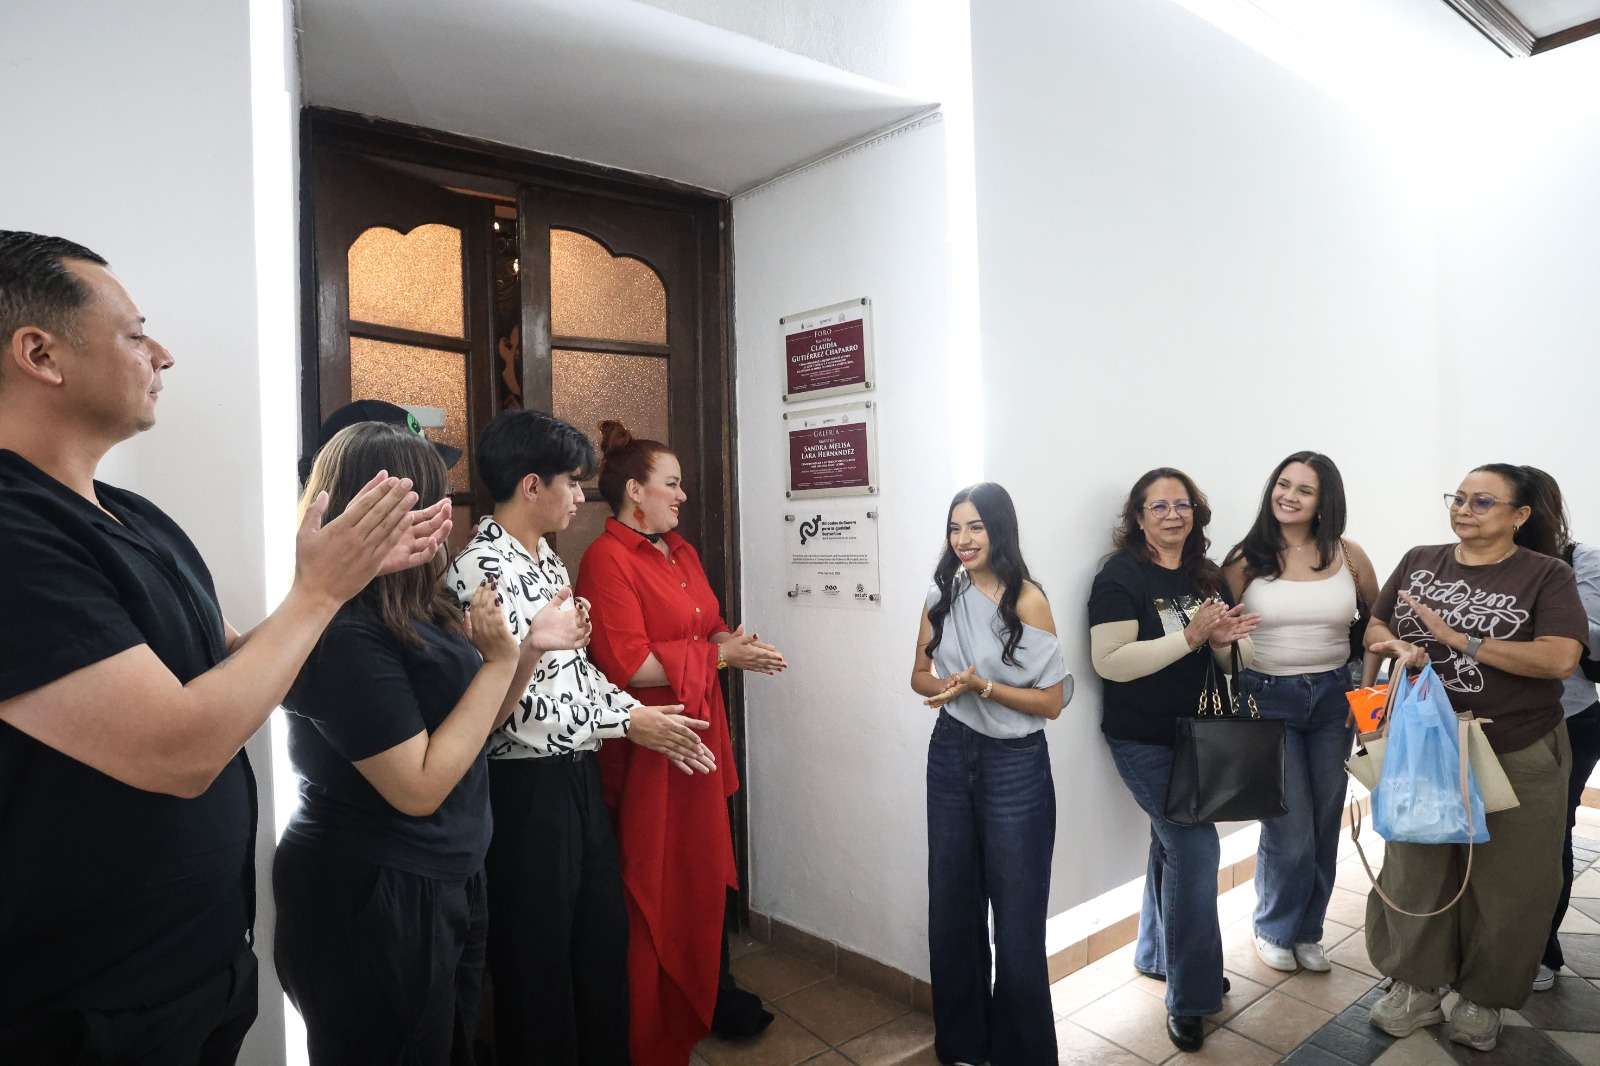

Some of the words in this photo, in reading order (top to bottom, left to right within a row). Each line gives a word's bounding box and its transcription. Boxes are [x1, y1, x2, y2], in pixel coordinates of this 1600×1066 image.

[814, 328, 832, 338] FORO
[810, 341, 837, 352] CLAUDIA
[825, 344, 859, 356] CHAPARRO
[804, 444, 828, 453] SANDRA
[829, 441, 852, 450] MELISA
[801, 452, 817, 460] LARA
